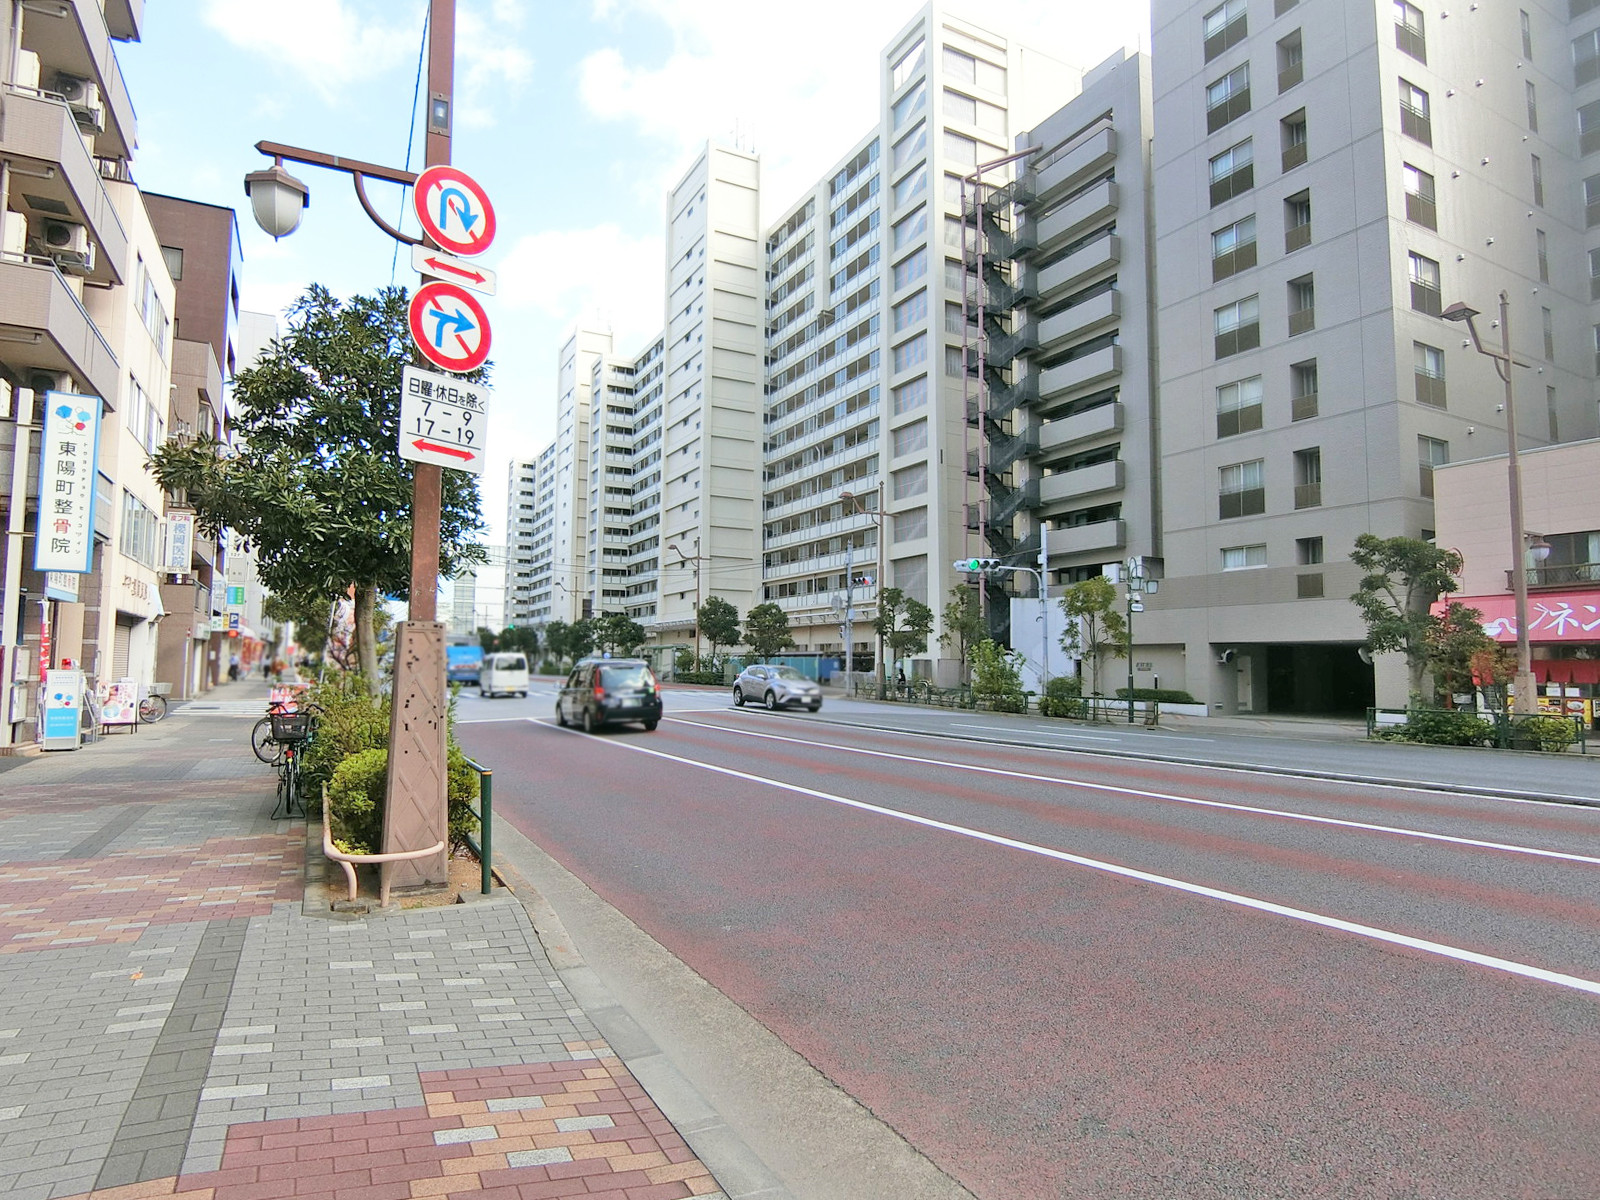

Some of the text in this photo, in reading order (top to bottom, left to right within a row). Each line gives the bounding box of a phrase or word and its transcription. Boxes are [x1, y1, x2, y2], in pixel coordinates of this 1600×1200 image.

[408, 377, 485, 412] 日曜・休日を除く
[51, 440, 78, 554] 東陽町整骨院
[230, 614, 239, 623] P
